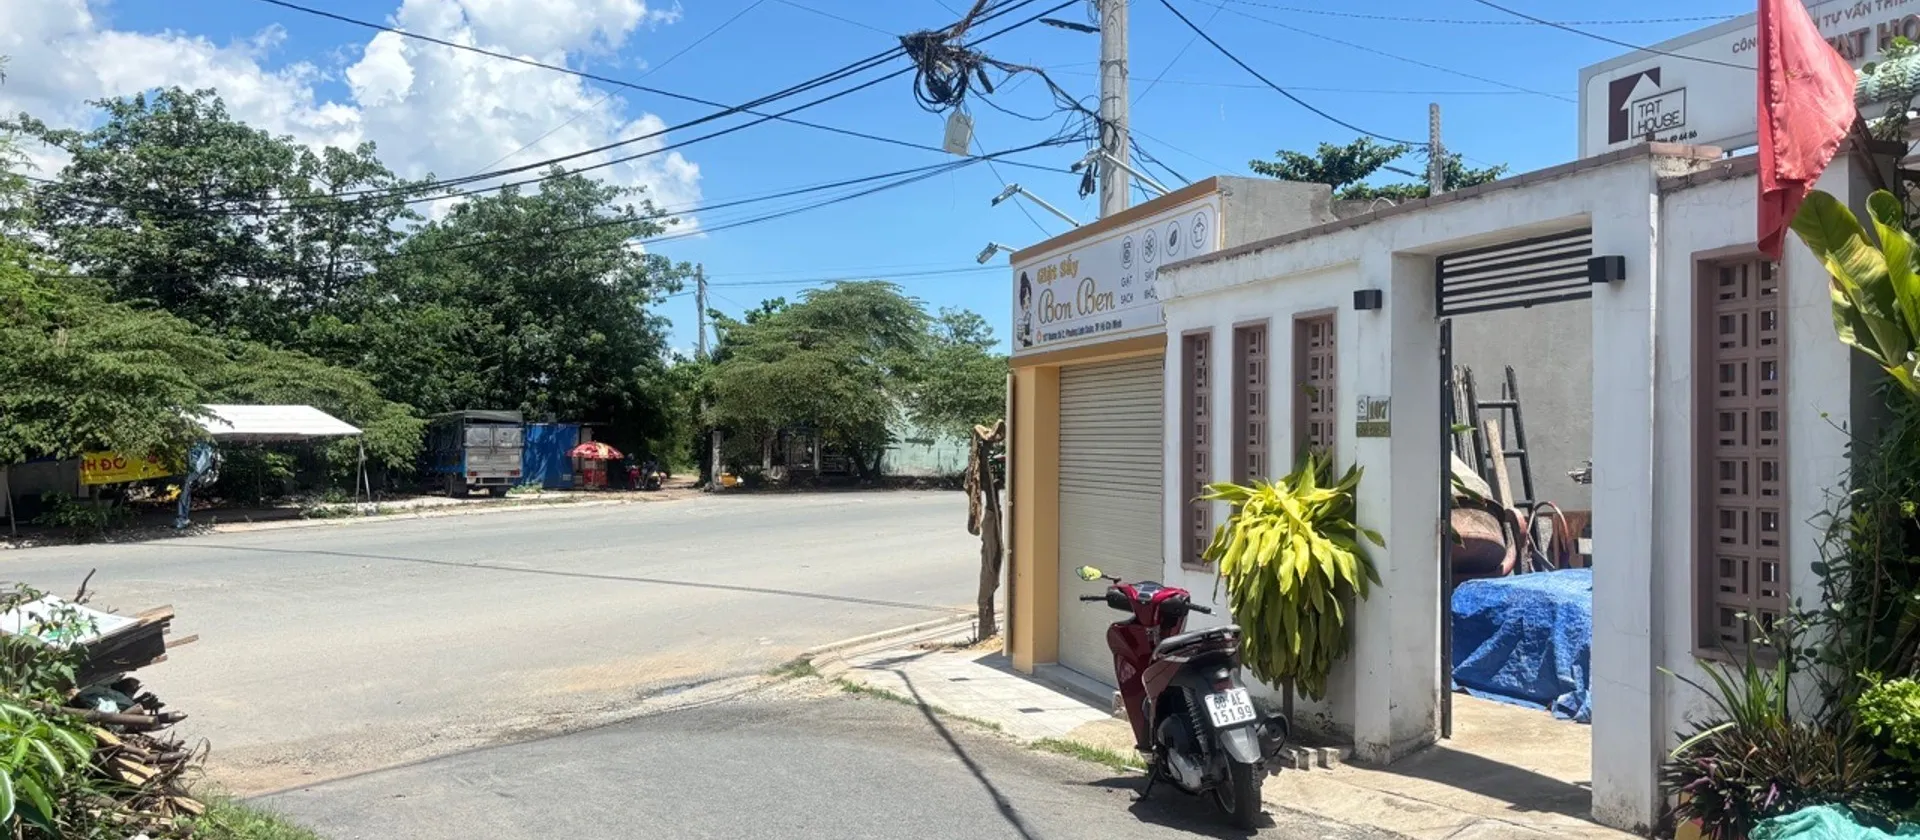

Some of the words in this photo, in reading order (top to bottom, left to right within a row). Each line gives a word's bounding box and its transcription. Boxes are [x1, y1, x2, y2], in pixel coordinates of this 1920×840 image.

[1732, 37, 1757, 53] CÔN
[1638, 99, 1663, 118] TAT
[1638, 110, 1680, 134] HOUSE
[1039, 288, 1073, 324] Bon
[1077, 277, 1116, 316] Ben
[1369, 400, 1388, 420] 107
[1214, 704, 1253, 724] 151.99
